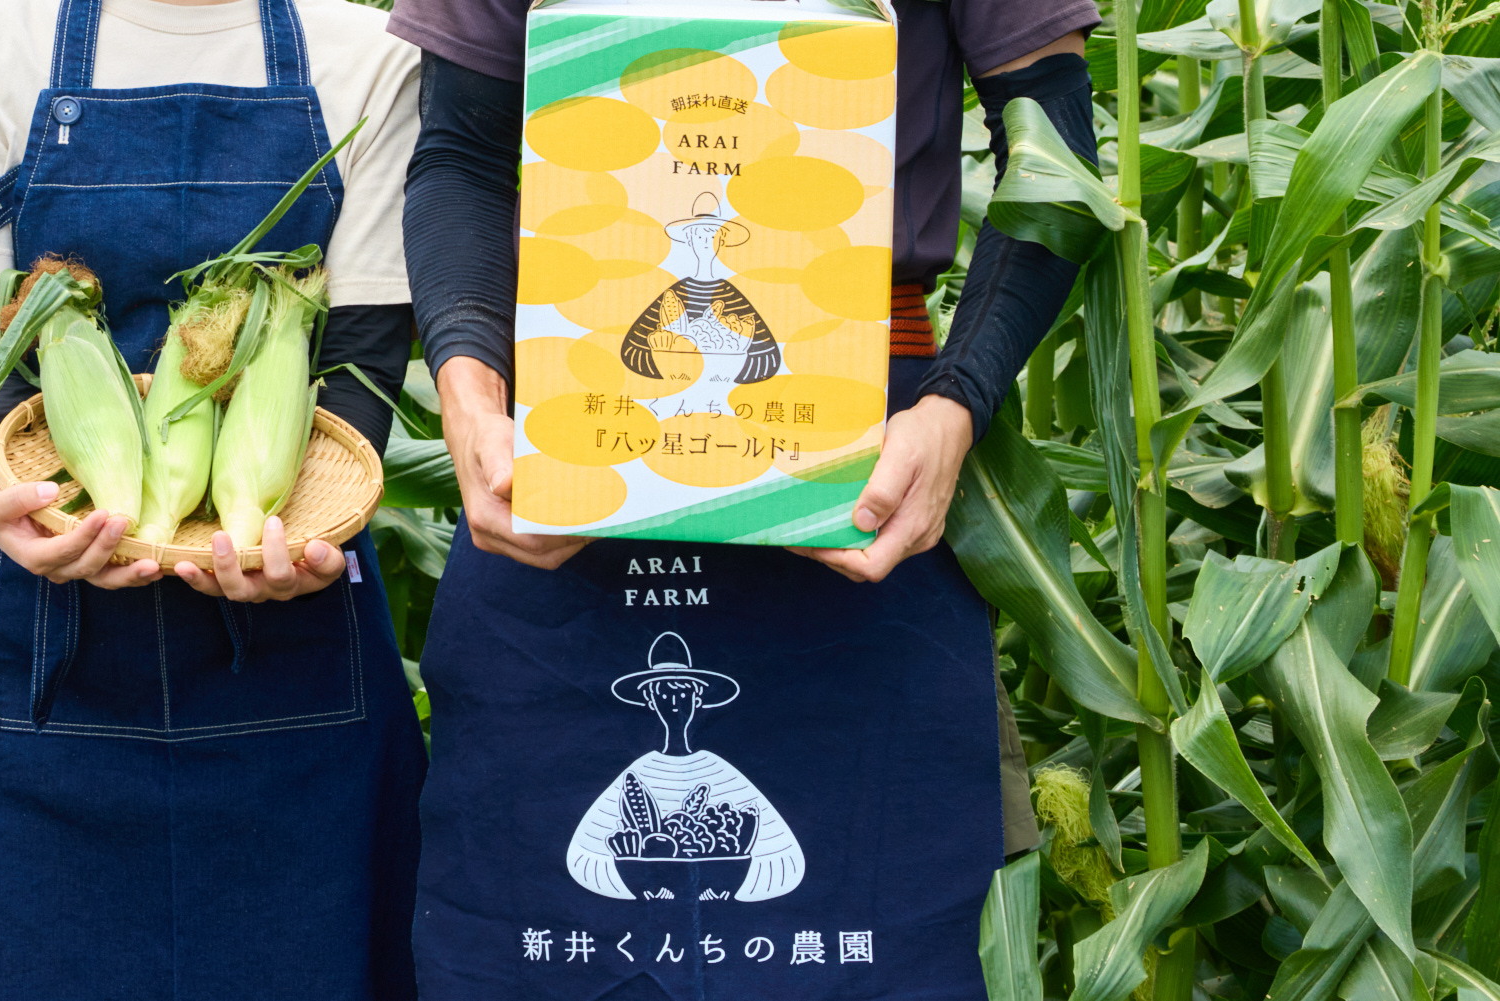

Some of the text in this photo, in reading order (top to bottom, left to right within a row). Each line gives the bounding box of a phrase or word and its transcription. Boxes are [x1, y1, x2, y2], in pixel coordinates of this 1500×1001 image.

[670, 93, 749, 115] 朝採れ直送
[678, 134, 739, 150] ARAI
[672, 160, 742, 177] FARM
[583, 393, 815, 425] 新井くんちの農園
[626, 556, 703, 575] ARAI
[624, 588, 710, 607] FARM
[521, 927, 875, 966] 新井くんちの農園
